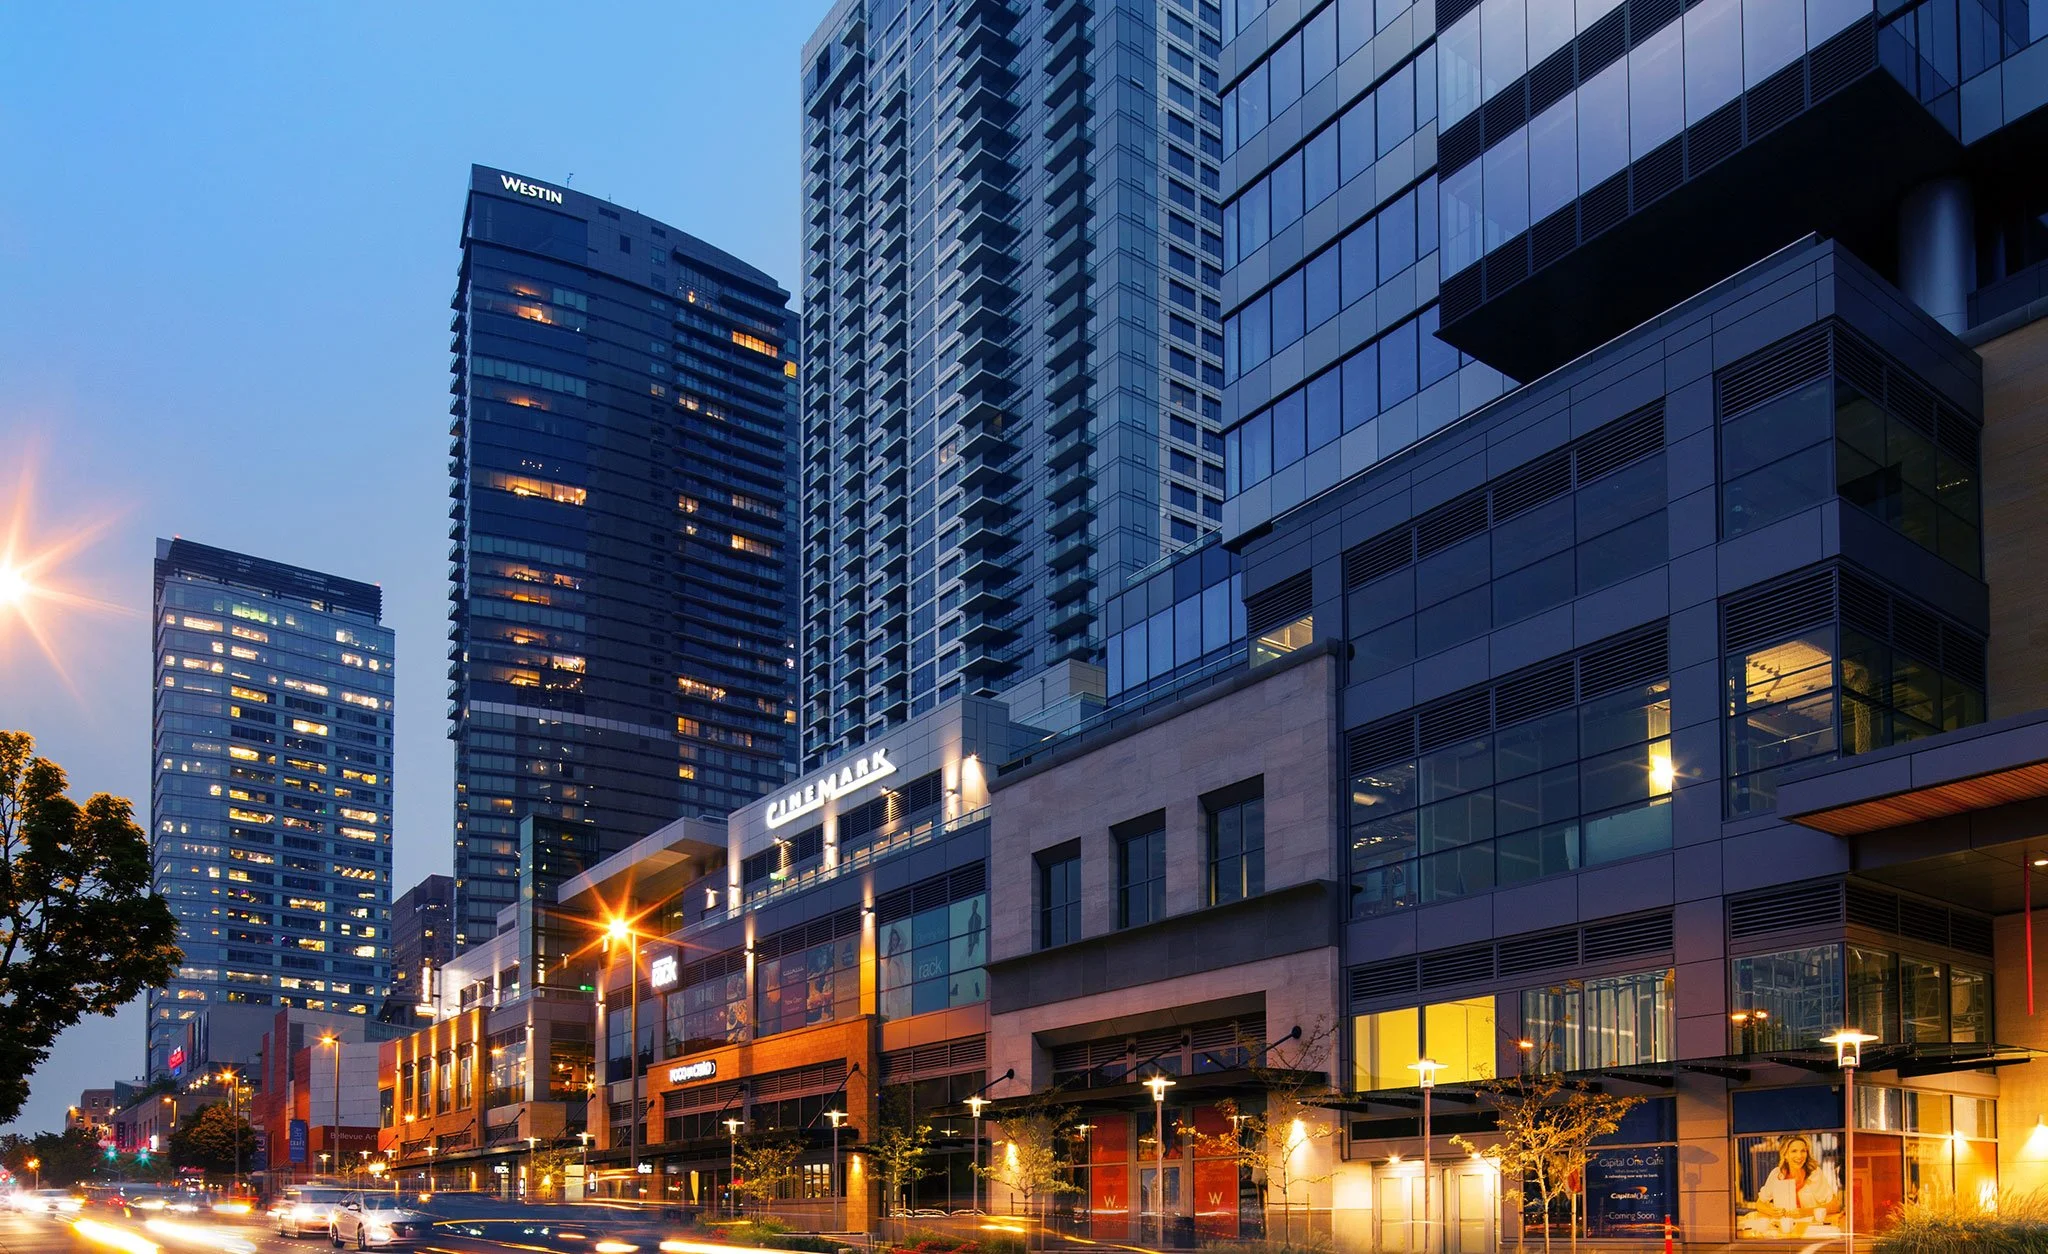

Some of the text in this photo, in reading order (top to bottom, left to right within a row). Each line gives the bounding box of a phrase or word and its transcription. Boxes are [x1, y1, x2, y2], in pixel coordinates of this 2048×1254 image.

[501, 174, 563, 205] WESTIN
[766, 748, 897, 829] CINEMARK
[918, 956, 943, 978] rack
[365, 1133, 378, 1141] Art
[1599, 1158, 1625, 1168] Capital
[1104, 1196, 1116, 1208] W
[1209, 1192, 1223, 1206] W
[1637, 1211, 1656, 1220] Soon
